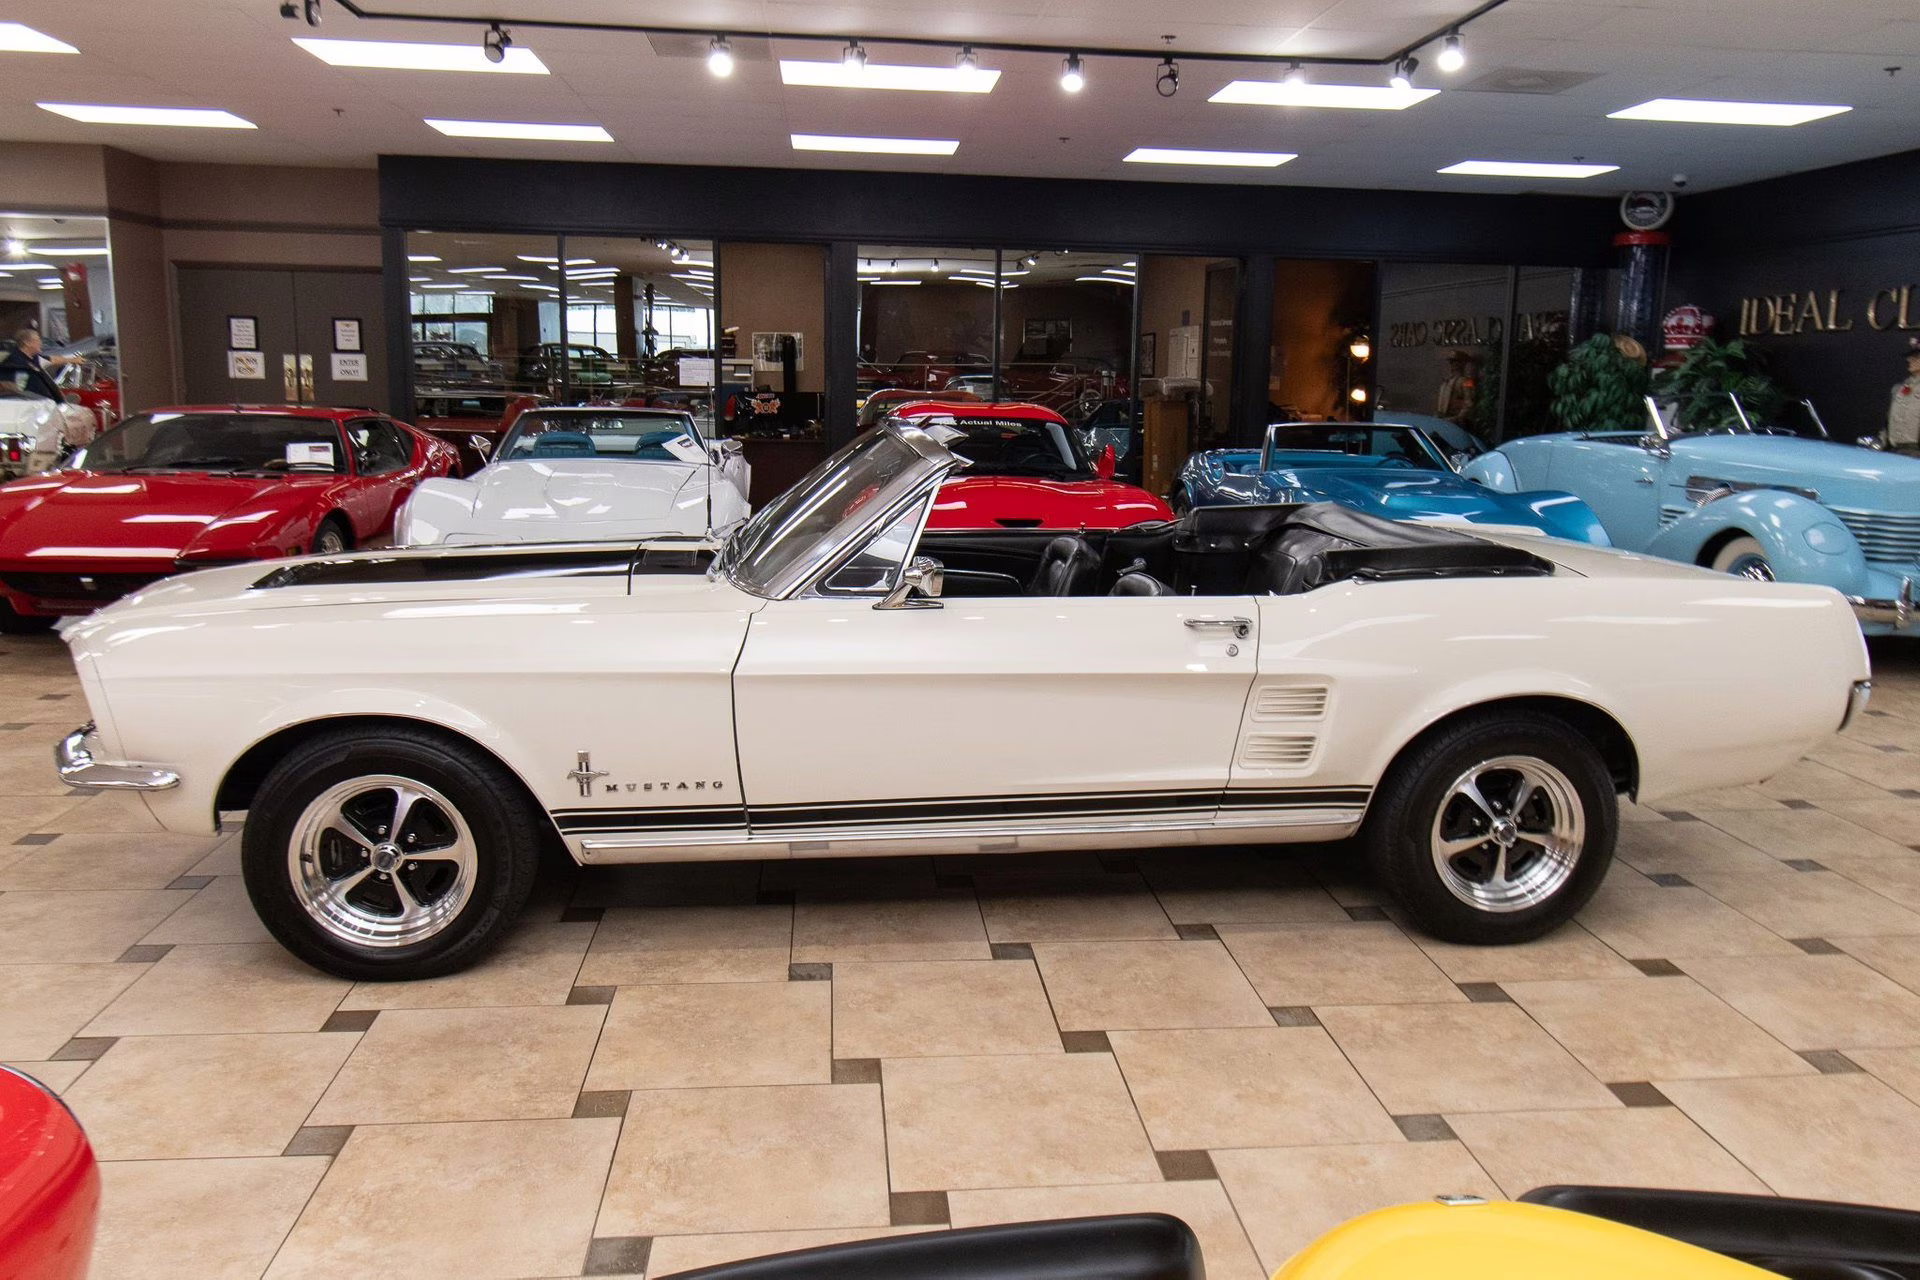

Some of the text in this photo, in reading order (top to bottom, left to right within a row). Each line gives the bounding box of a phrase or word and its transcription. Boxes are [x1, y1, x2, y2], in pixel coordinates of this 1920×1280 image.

[1740, 283, 1920, 336] IDEAL CL
[605, 781, 723, 793] MUSTANG
